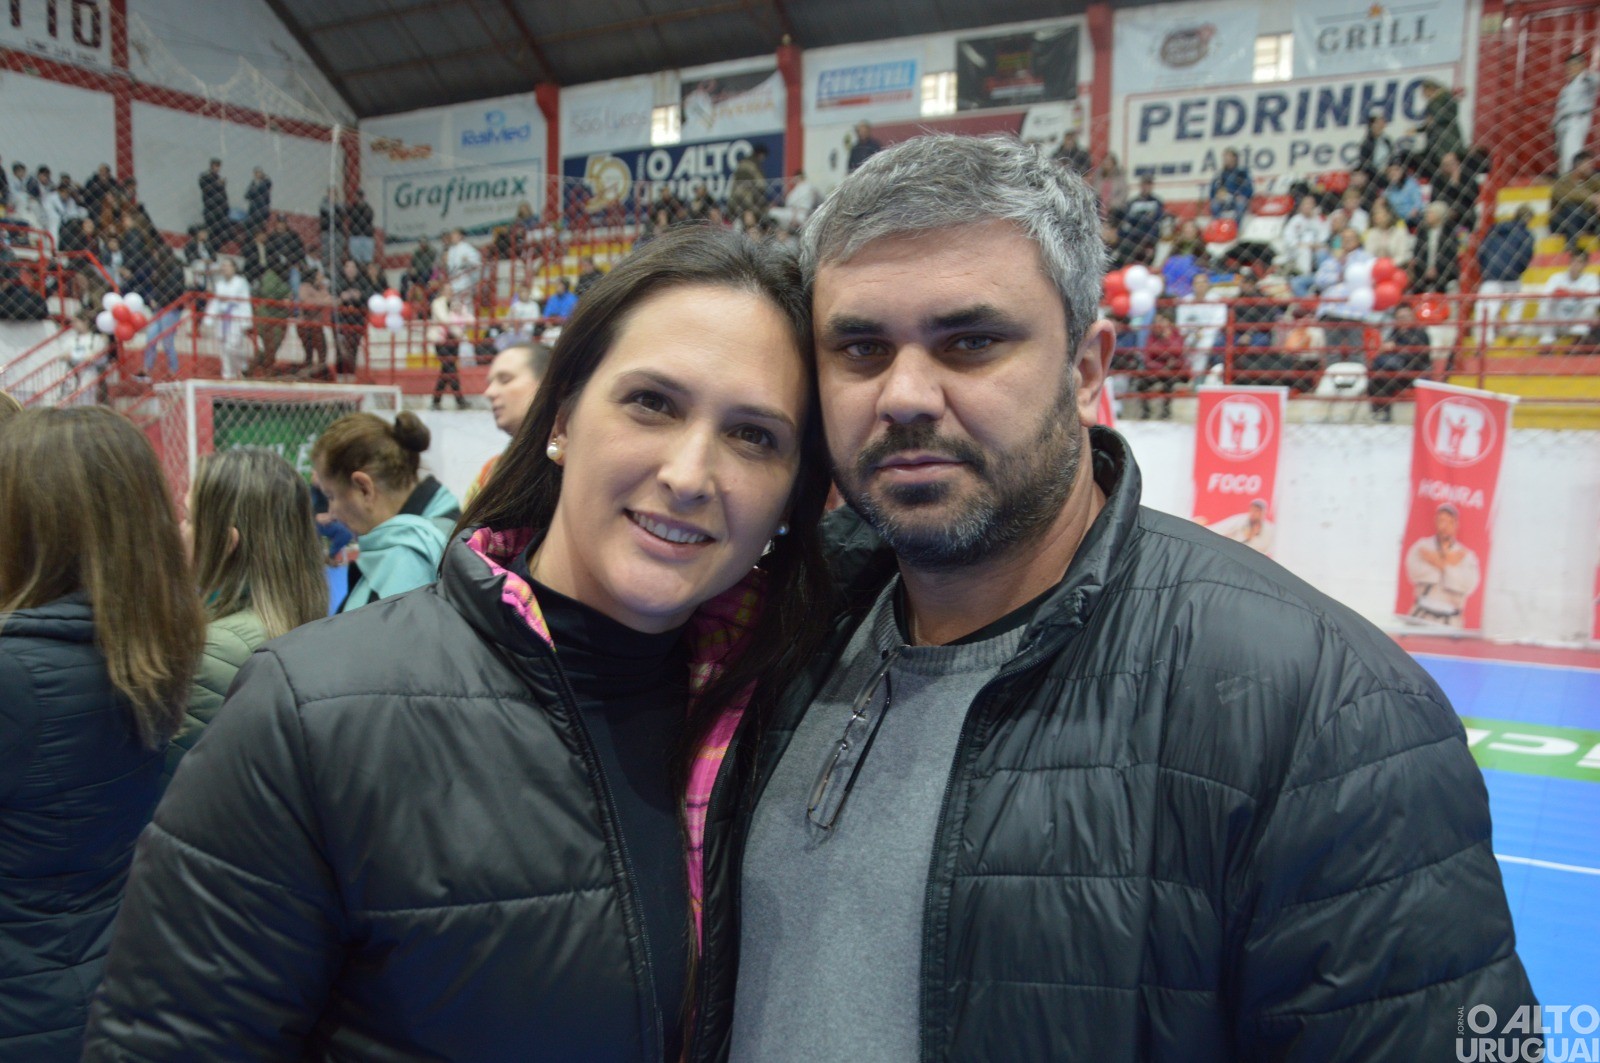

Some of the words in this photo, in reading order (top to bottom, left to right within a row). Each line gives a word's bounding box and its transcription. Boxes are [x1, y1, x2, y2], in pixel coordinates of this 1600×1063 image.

[1316, 15, 1436, 55] GRILL
[1138, 79, 1428, 144] PEDRINHO
[647, 149, 672, 181] O
[672, 140, 753, 180] ALTO
[1200, 147, 1276, 173] Ato
[394, 174, 528, 221] Grafimax
[1207, 472, 1262, 495] FOCO
[1418, 478, 1484, 510] HONRA
